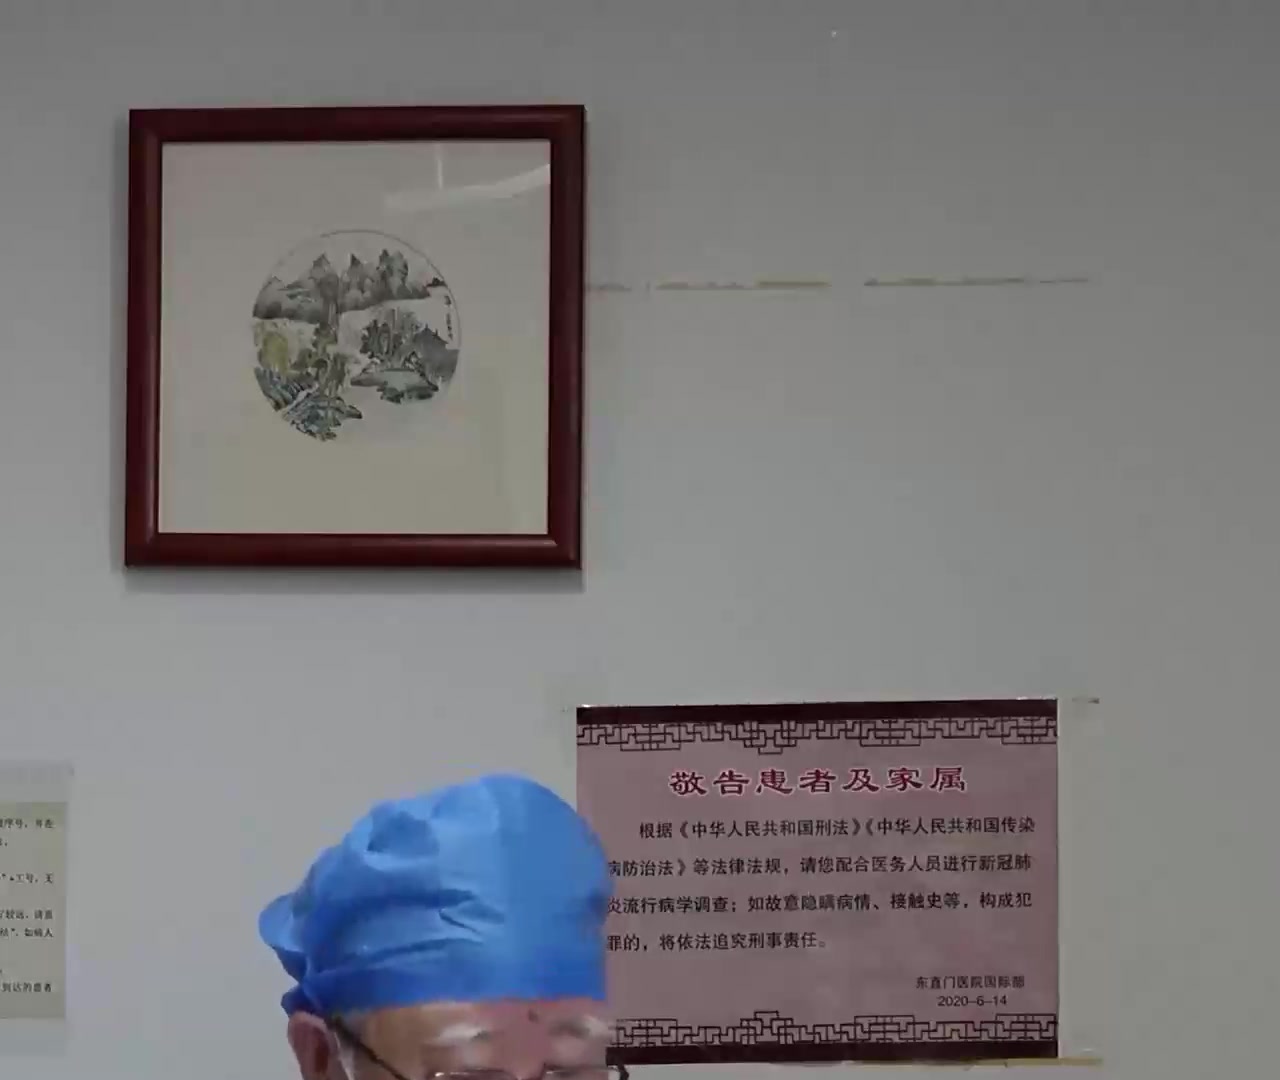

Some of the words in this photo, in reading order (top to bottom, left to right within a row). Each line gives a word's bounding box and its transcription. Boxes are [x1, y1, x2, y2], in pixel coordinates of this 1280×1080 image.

[669, 767, 967, 796] 敬告患者及家属
[639, 816, 1035, 839] 根据《中华人民共和国刑法》《中华人民共和国传染
[608, 932, 826, 951] 罪的，将依法追究刑事责任。
[937, 994, 1008, 1007] 2020-6-14
